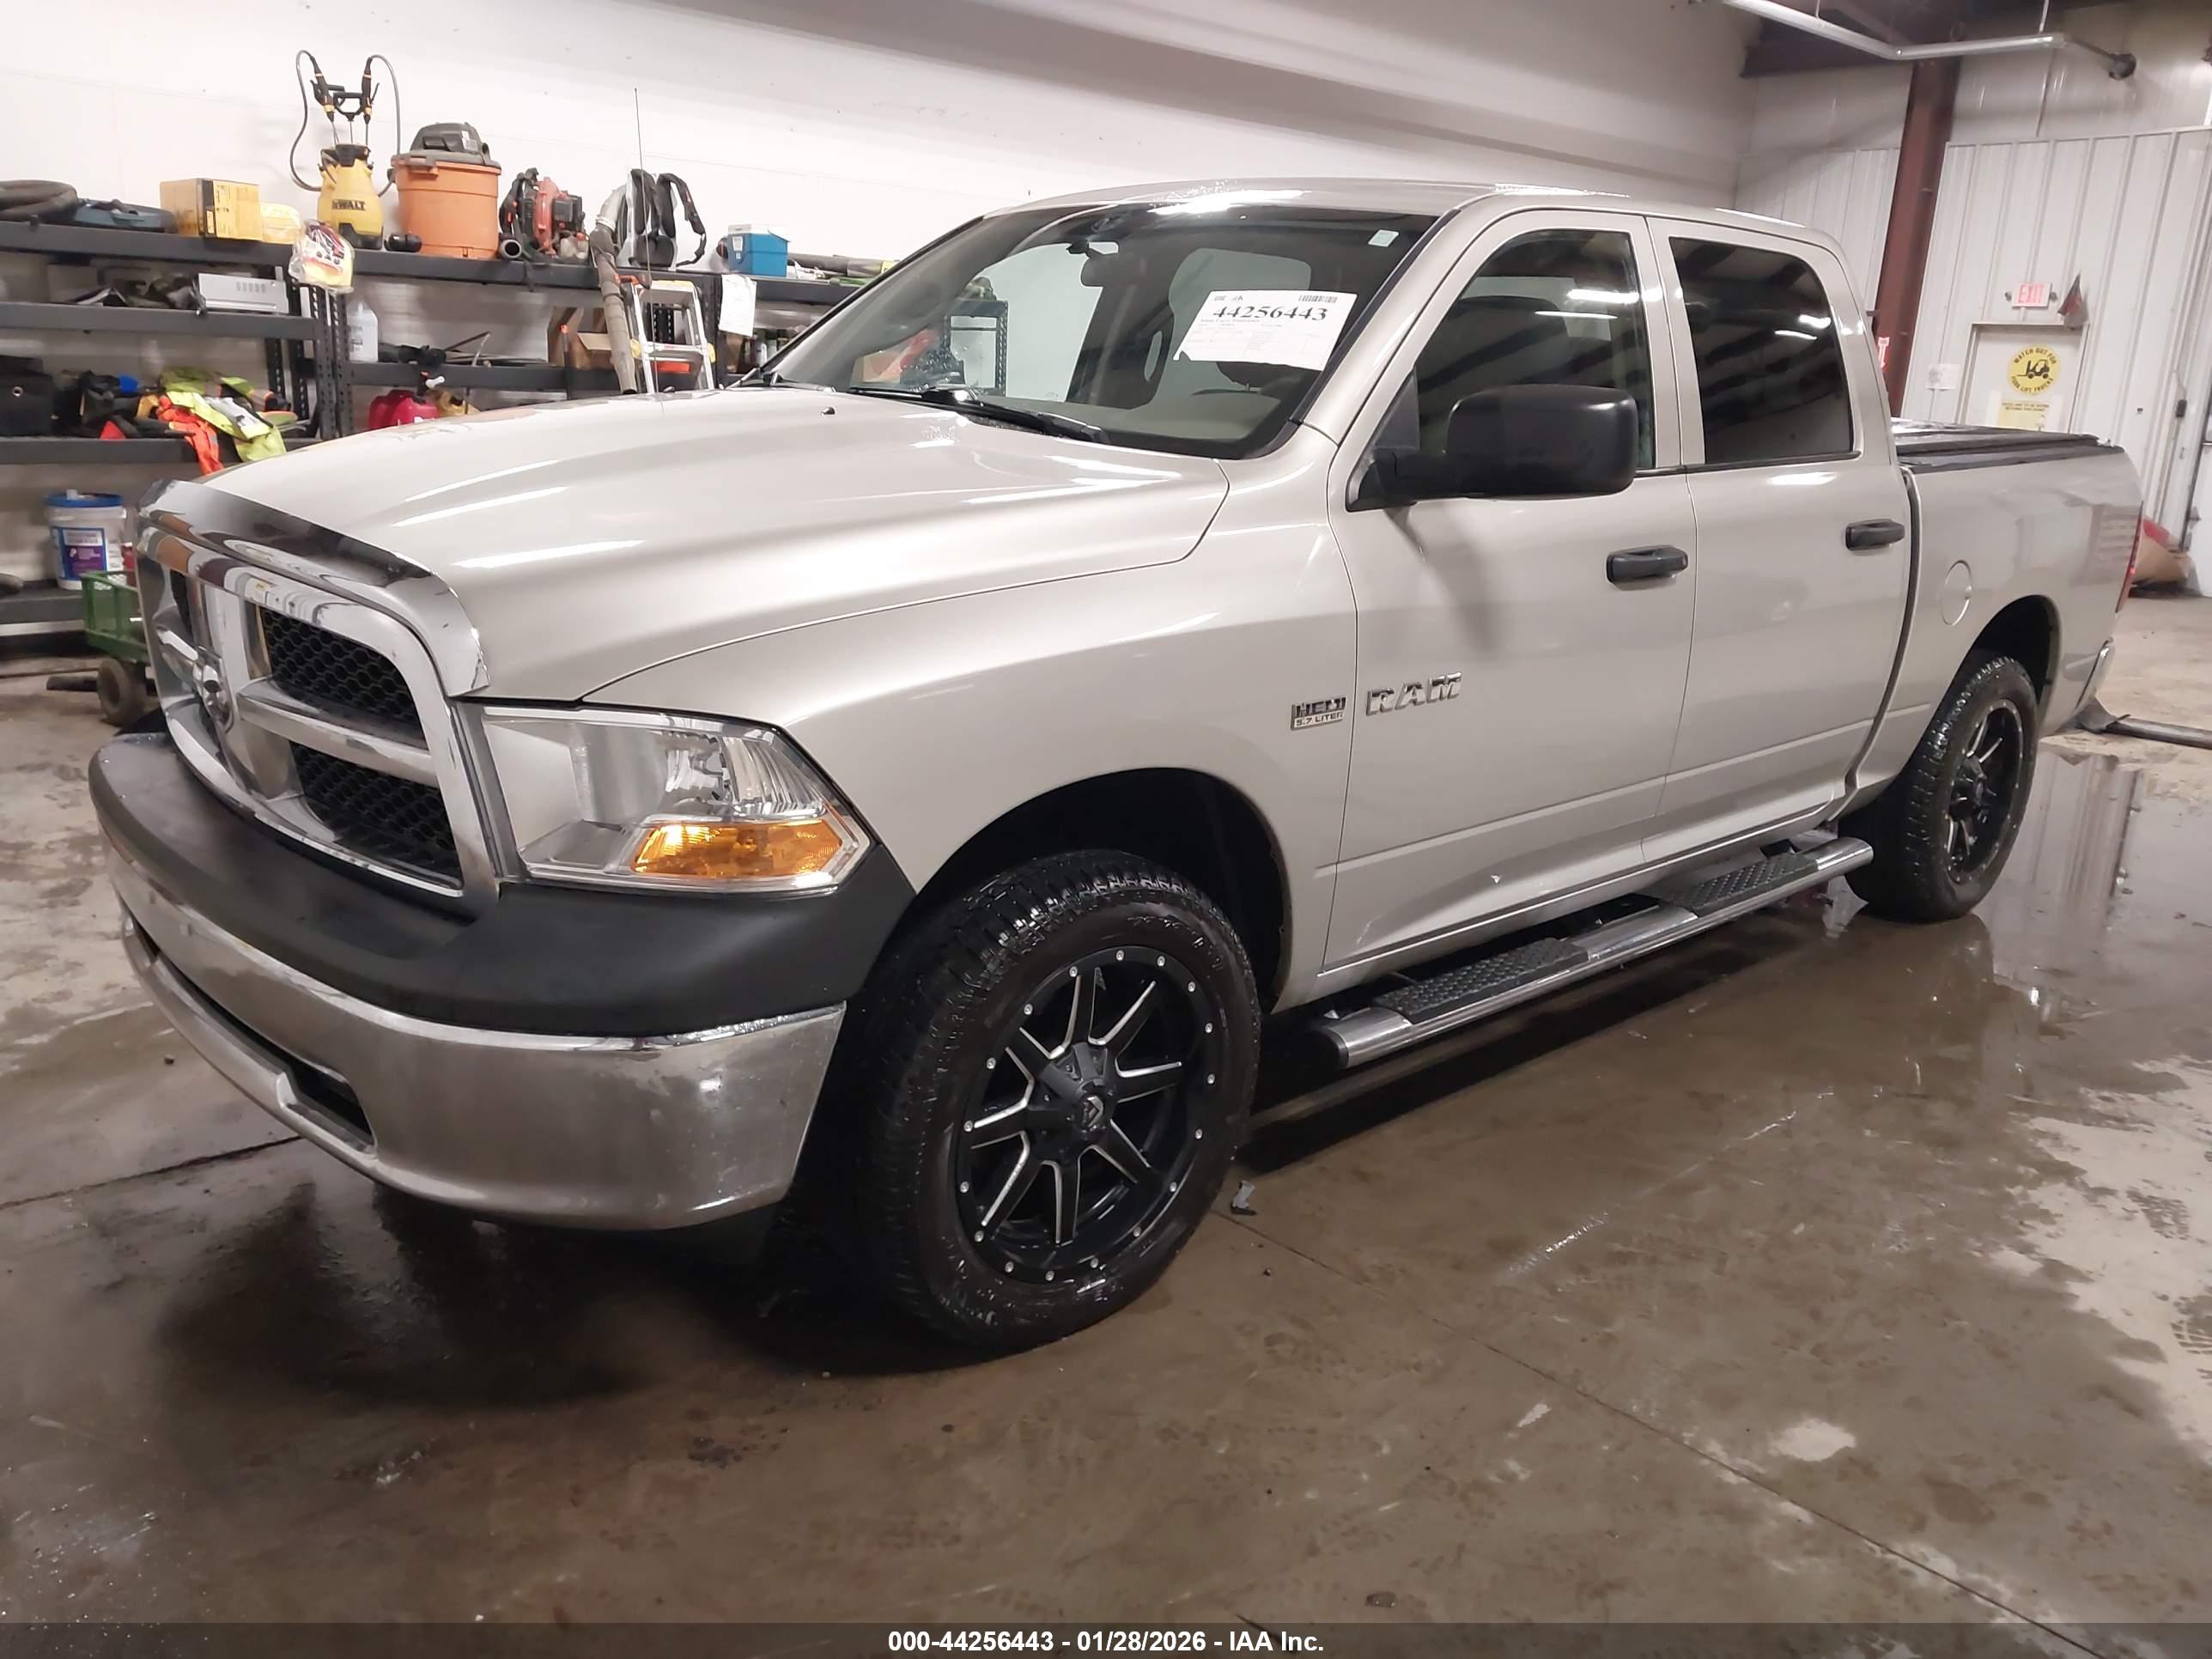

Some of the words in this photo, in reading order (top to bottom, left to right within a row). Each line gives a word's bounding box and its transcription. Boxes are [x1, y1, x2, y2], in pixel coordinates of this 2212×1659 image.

[2018, 284, 2045, 303] EXIT
[1212, 306, 1328, 321] 44256443
[1365, 672, 1462, 717] RAM
[1295, 696, 1346, 719] HEMI
[1296, 717, 1313, 727] 5.7
[1315, 711, 1344, 723] LITER
